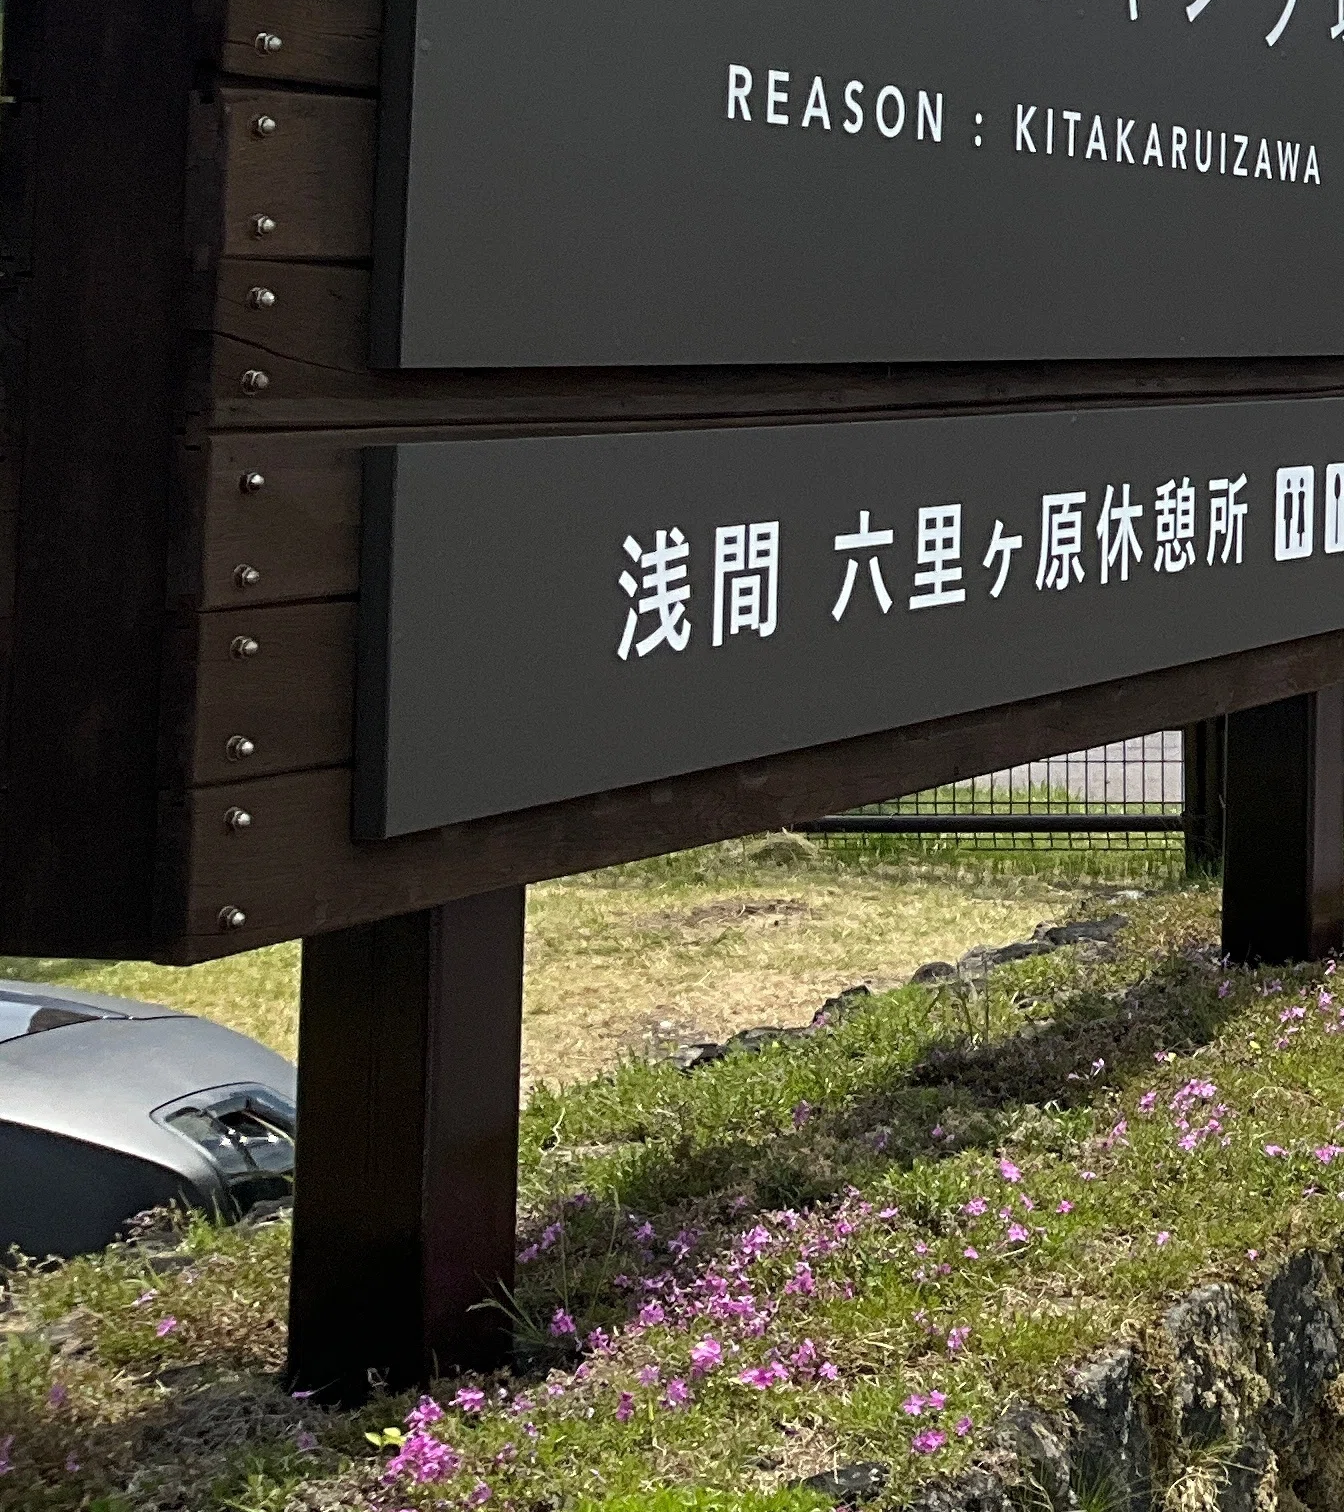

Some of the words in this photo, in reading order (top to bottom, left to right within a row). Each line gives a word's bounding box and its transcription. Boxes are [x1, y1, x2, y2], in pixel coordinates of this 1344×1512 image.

[727, 64, 944, 142] REASON
[1016, 103, 1322, 186] KITAKARUIZAWA
[616, 520, 781, 660] 浅間
